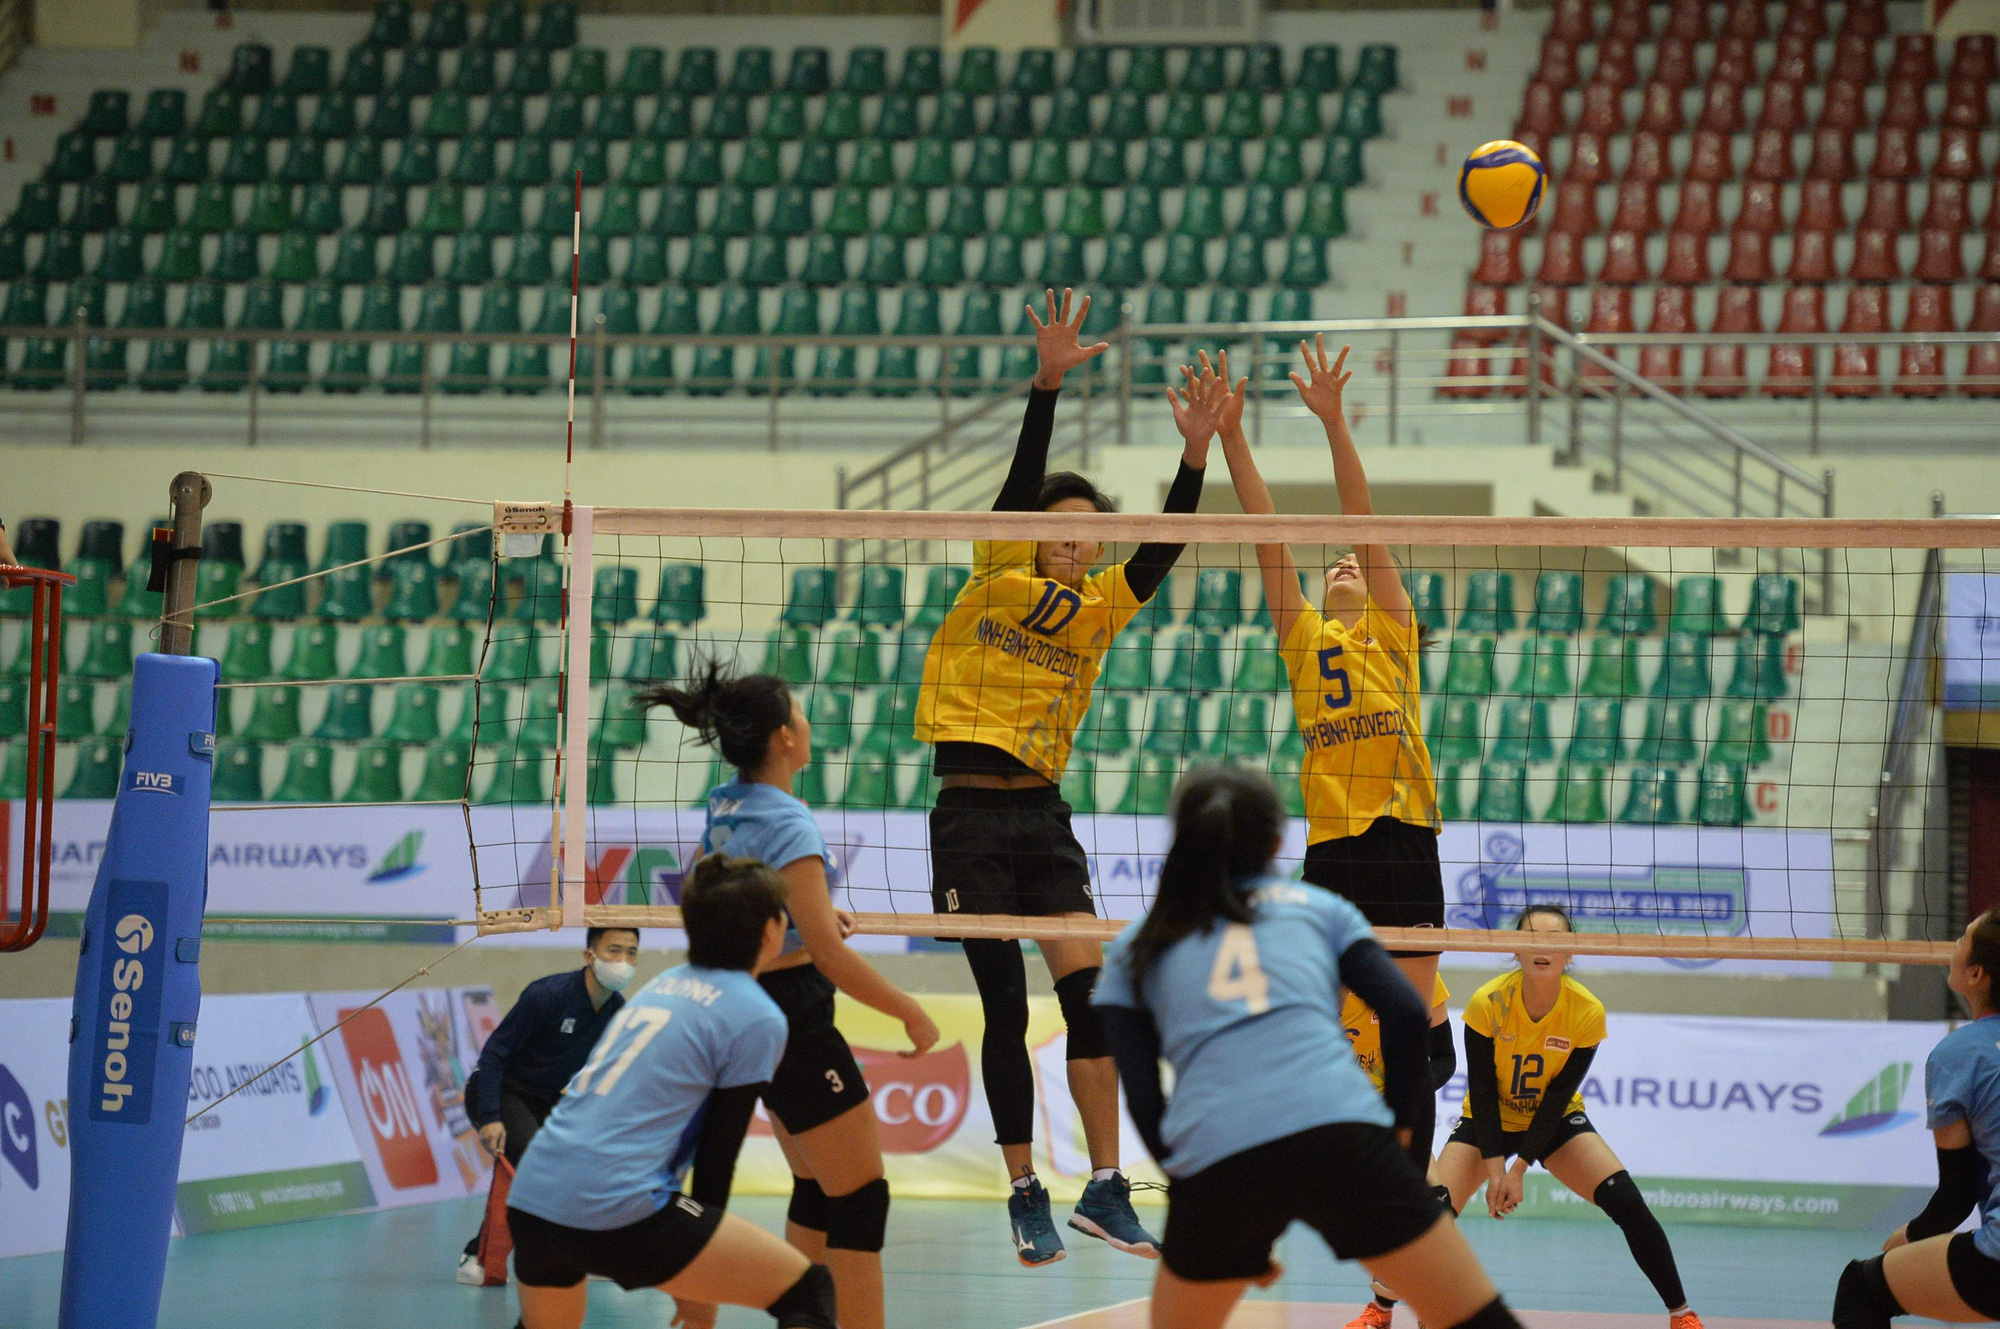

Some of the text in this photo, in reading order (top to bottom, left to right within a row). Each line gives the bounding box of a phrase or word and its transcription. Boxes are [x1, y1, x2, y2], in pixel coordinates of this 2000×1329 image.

[511, 506, 546, 514] Senoh
[1021, 580, 1082, 636] 10
[1028, 640, 1079, 678] DOVECO
[1317, 645, 1353, 710] 5
[1349, 710, 1404, 741] DOVECO
[135, 771, 172, 788] FIVB
[208, 842, 368, 869] AIRWAYS
[945, 888, 960, 912] 10
[1208, 922, 1271, 1015] 4
[101, 957, 144, 1112] Senoh
[575, 1006, 672, 1096] 17
[825, 1068, 845, 1093] 3
[1510, 1053, 1544, 1096] 12
[1583, 1076, 1824, 1114] AIRWAYS
